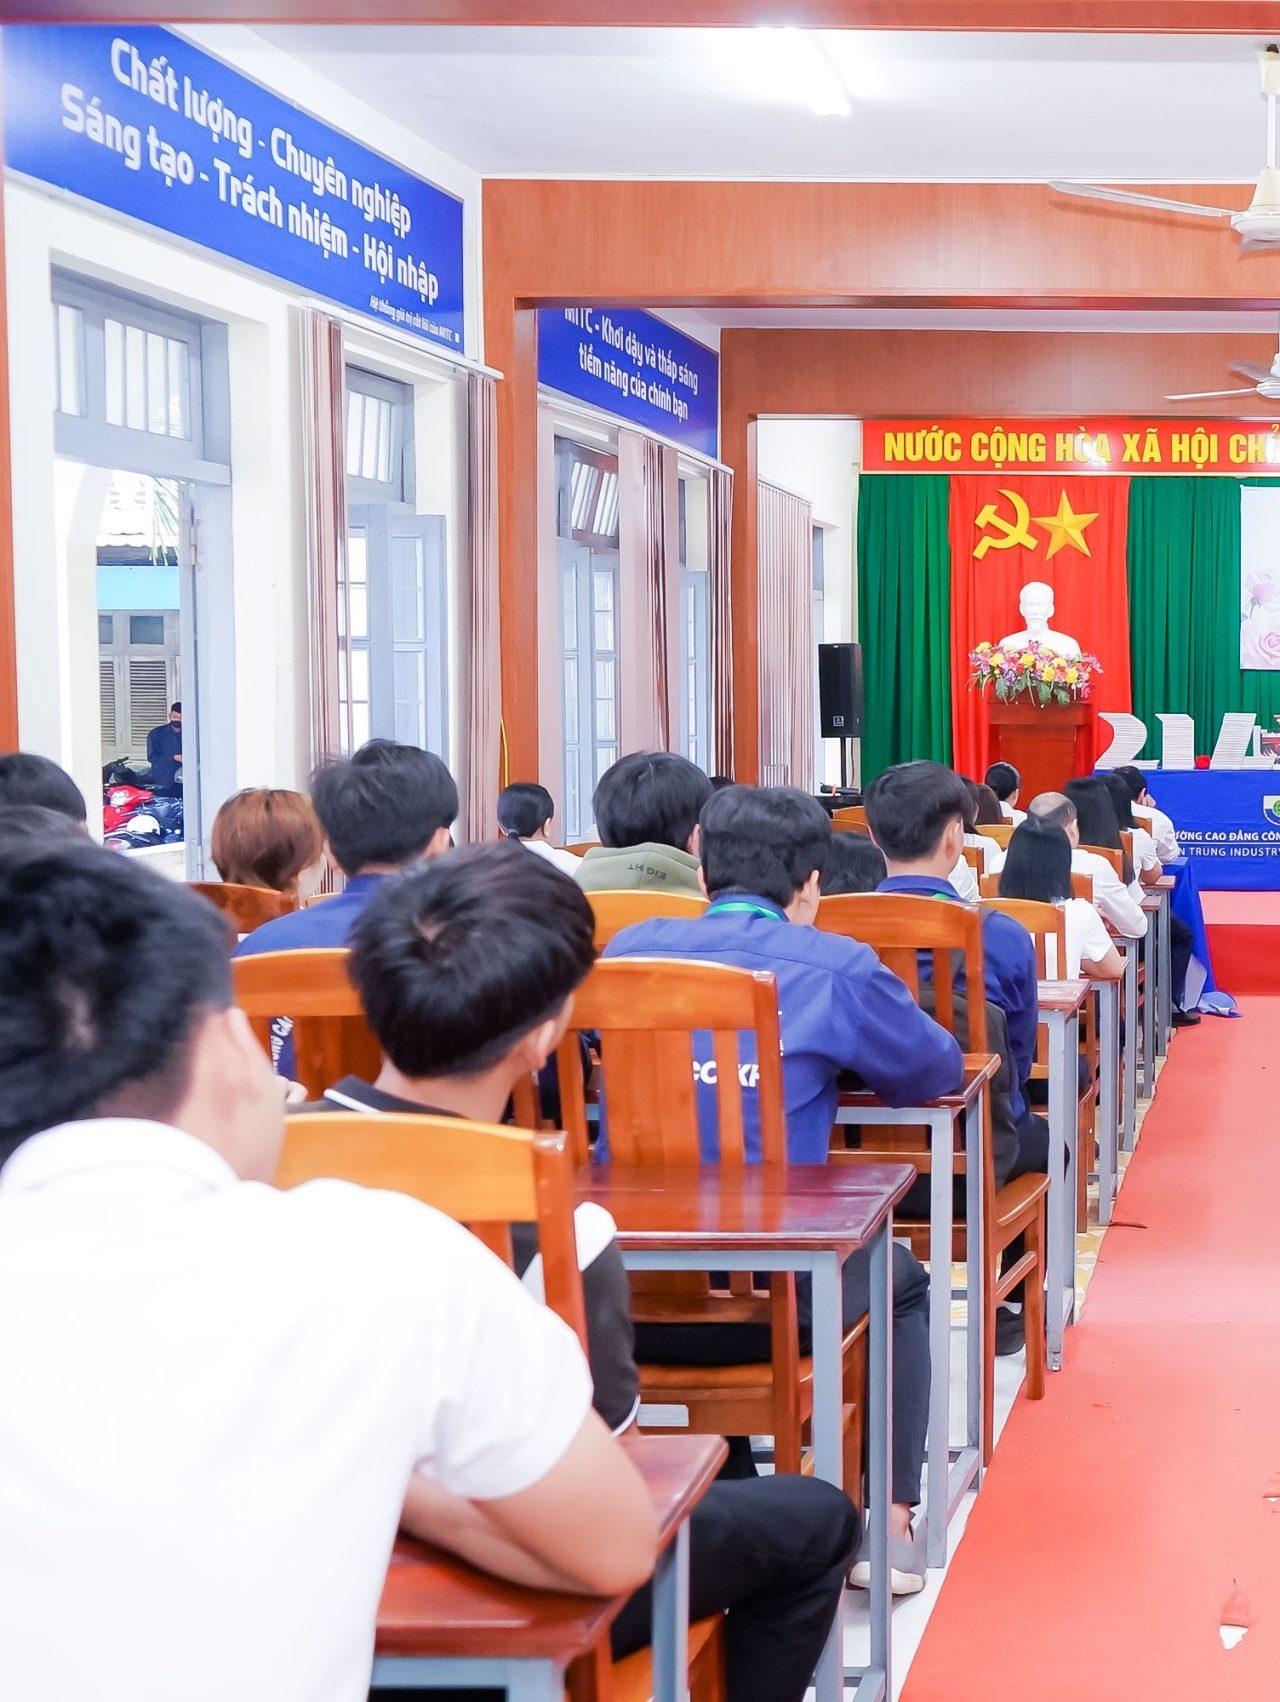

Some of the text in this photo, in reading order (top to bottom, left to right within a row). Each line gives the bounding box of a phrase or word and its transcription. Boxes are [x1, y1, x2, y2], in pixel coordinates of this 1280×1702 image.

[110, 37, 179, 111] Chất
[183, 76, 254, 158] lượng
[270, 126, 348, 199] Chuyên
[351, 177, 411, 238] nghiệp
[60, 83, 141, 171] Sáng
[147, 125, 195, 188] tạo
[213, 158, 283, 229] Trách
[288, 199, 348, 260] nhiệm
[363, 233, 394, 284] Hội
[397, 260, 439, 305] nhập
[579, 342, 689, 423] tiềm năng của chính bạn
[625, 331, 643, 367] dậy
[644, 344, 656, 369] và
[658, 349, 678, 385] thắp
[678, 362, 699, 395] sáng
[884, 425, 963, 462] NƯỚC
[970, 425, 1047, 469] CỘNG
[1055, 425, 1112, 464] HÒA
[1122, 428, 1163, 463] XÃ
[1172, 427, 1218, 469] HỘI
[1174, 831, 1203, 841] ƯỜNG
[1204, 832, 1227, 841] CAO
[1189, 847, 1226, 857] TRUNG
